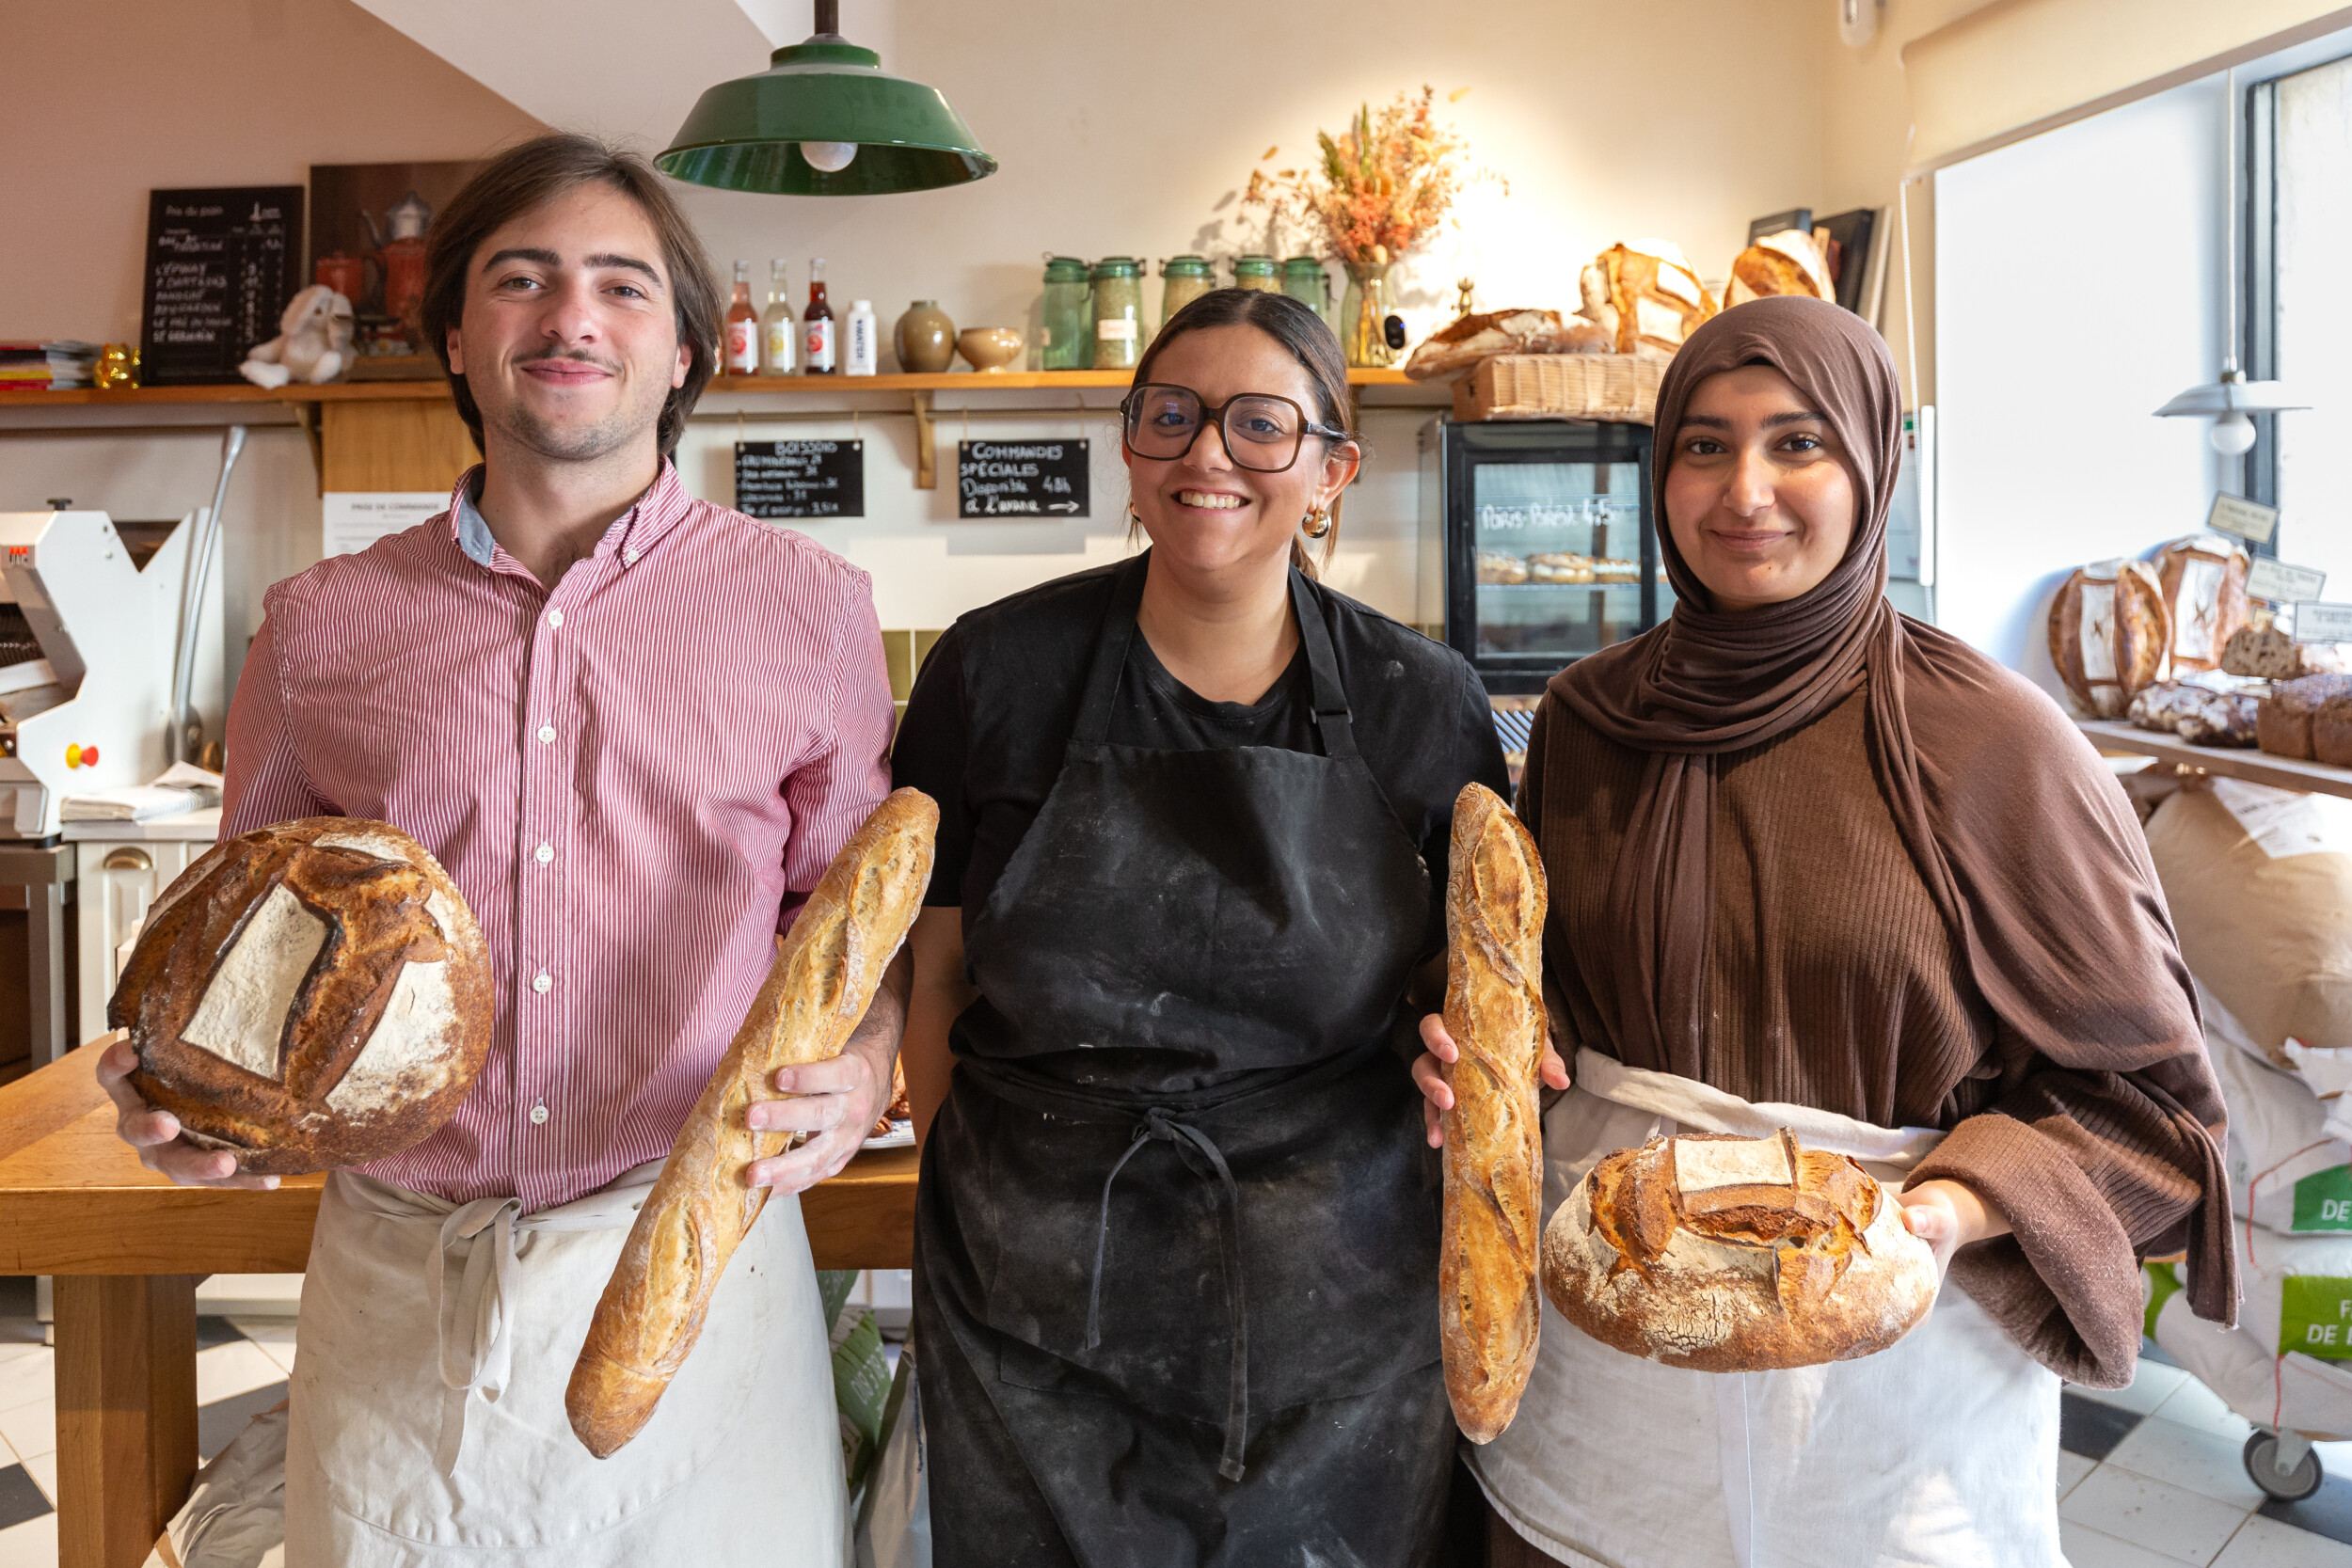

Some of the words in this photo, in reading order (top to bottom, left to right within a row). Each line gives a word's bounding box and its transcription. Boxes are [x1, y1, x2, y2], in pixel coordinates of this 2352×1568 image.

[972, 442, 1063, 460] COMMANDES
[960, 460, 1040, 477] SPÉCIALES
[1042, 475, 1072, 494] 48h
[2321, 1198, 2351, 1223] DE
[2306, 1323, 2339, 1345] DE
